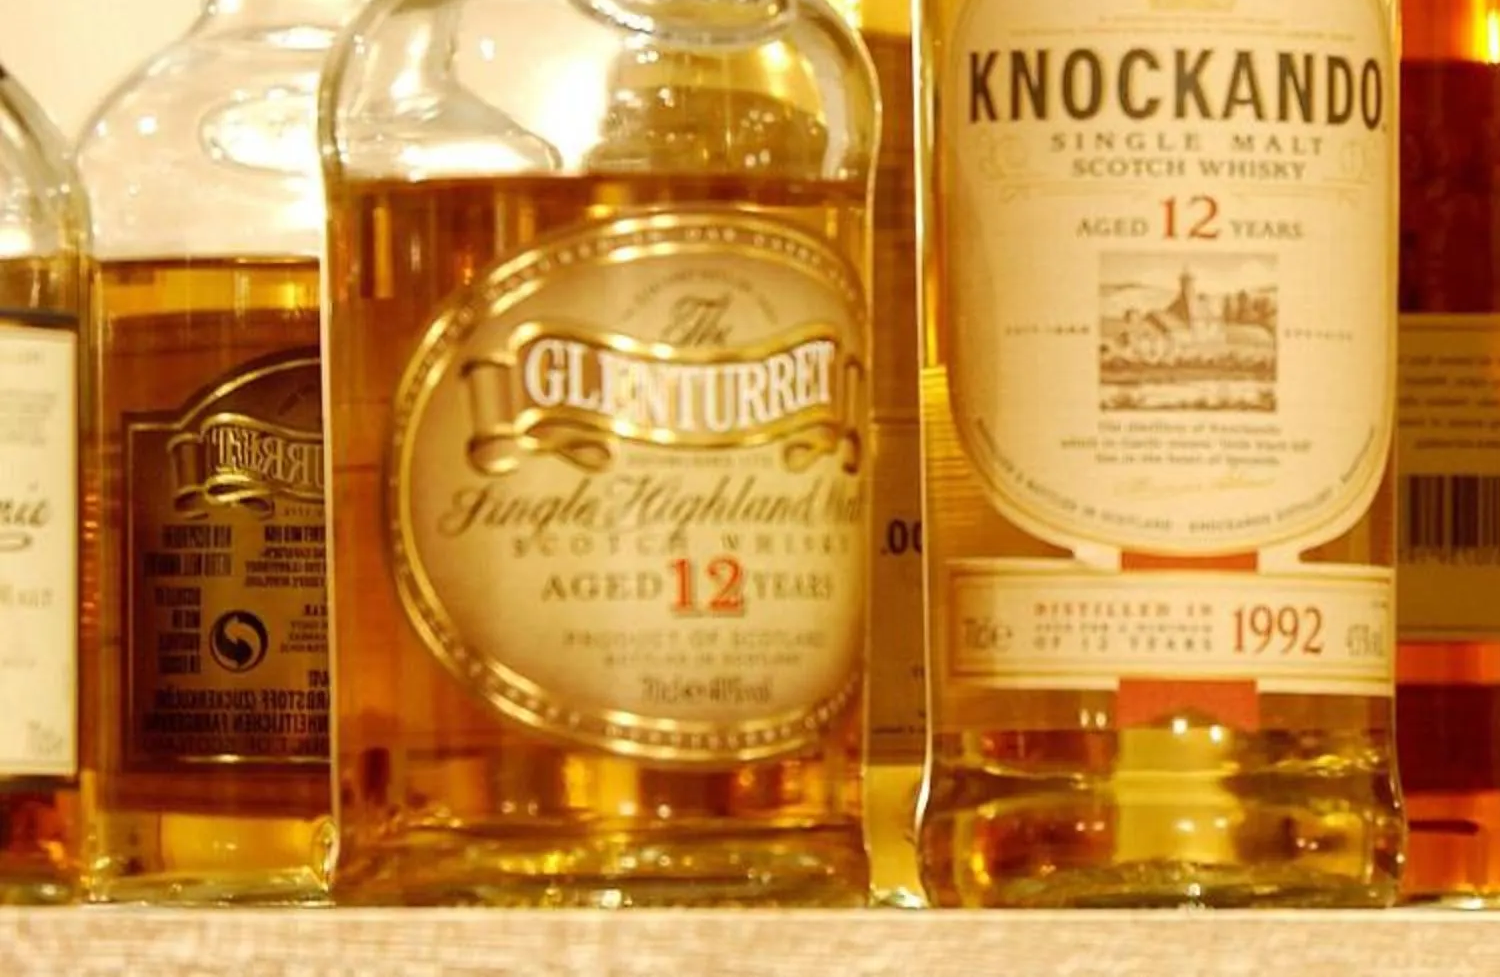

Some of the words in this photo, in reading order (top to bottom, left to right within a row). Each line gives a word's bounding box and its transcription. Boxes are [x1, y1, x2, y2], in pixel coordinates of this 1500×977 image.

[969, 49, 1383, 132] KNOCKANDO
[1050, 132, 1209, 154] SINGLE
[1232, 134, 1324, 157] MALT
[1072, 158, 1186, 178] SCOTCH
[1200, 159, 1307, 180] WHISKY
[1075, 219, 1149, 237] AGED
[1160, 196, 1222, 241] 12
[1230, 221, 1304, 239] YEARS
[525, 339, 837, 432] GLENTURRET
[440, 477, 597, 538] Single
[600, 473, 818, 536] Highland
[512, 532, 690, 558] SCOTCH
[541, 571, 663, 602] AGED
[669, 555, 746, 617] 12
[751, 571, 834, 602] YEARS
[1232, 605, 1324, 654] 1992
